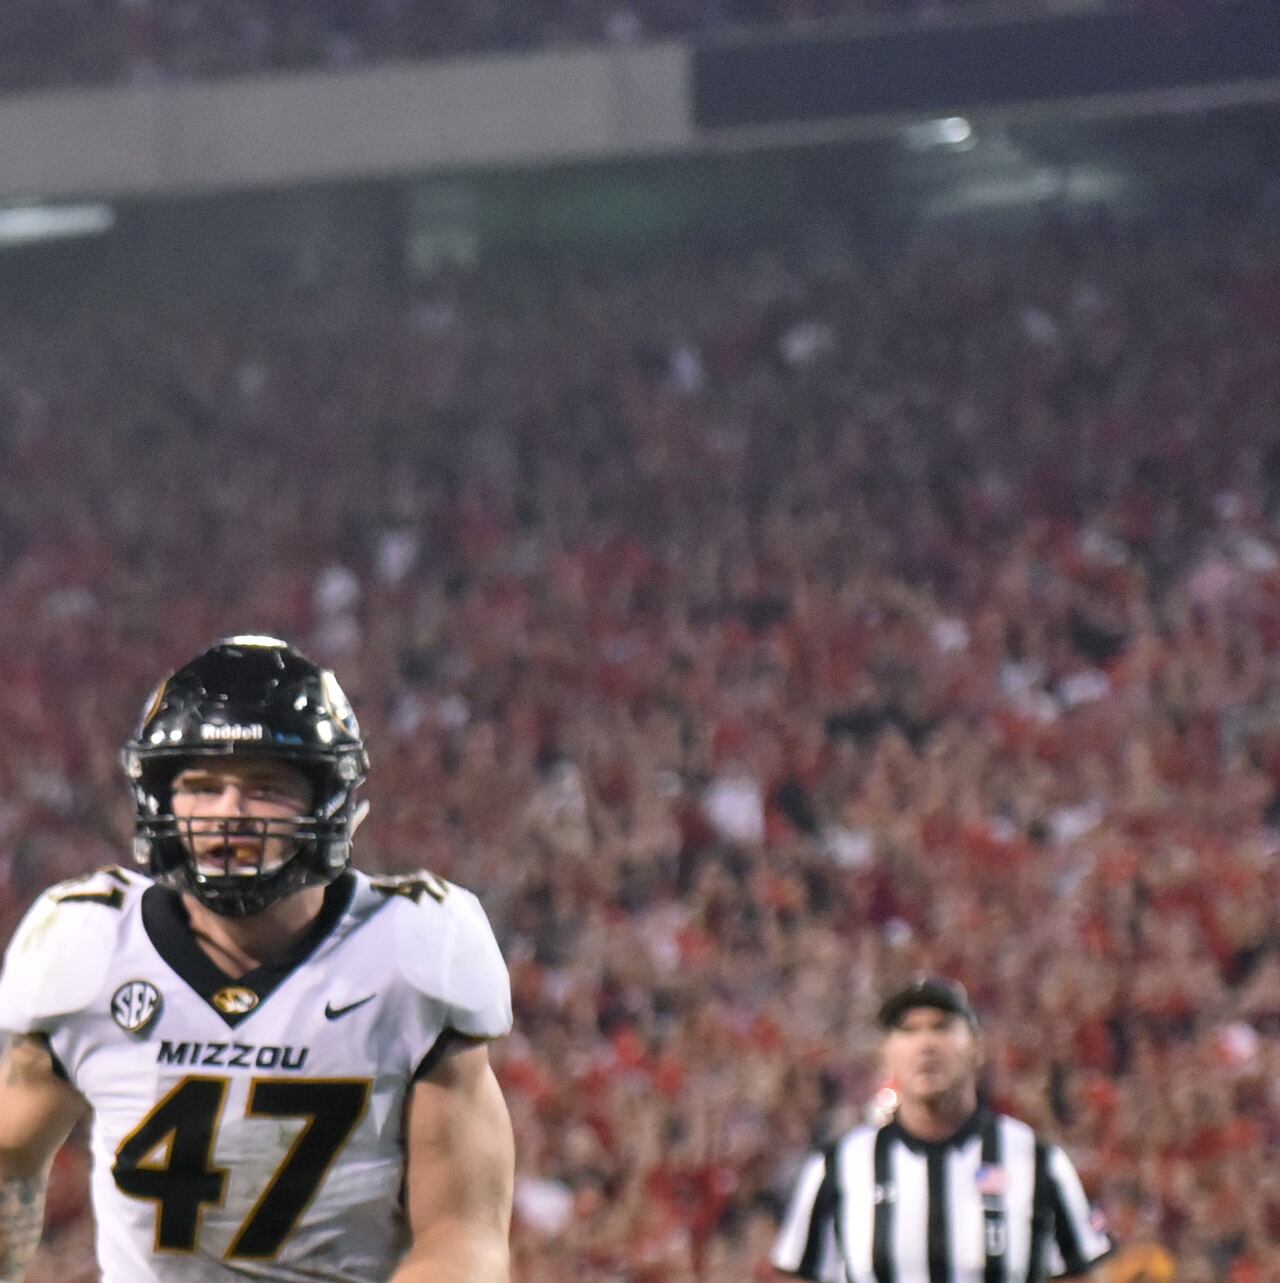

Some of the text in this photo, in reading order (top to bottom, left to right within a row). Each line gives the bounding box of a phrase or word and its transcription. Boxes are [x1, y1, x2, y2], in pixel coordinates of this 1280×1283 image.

[201, 723, 262, 740] Riddell
[114, 983, 160, 1030] SEC
[157, 1041, 309, 1069] MIZZOU
[112, 1075, 373, 1261] 47
